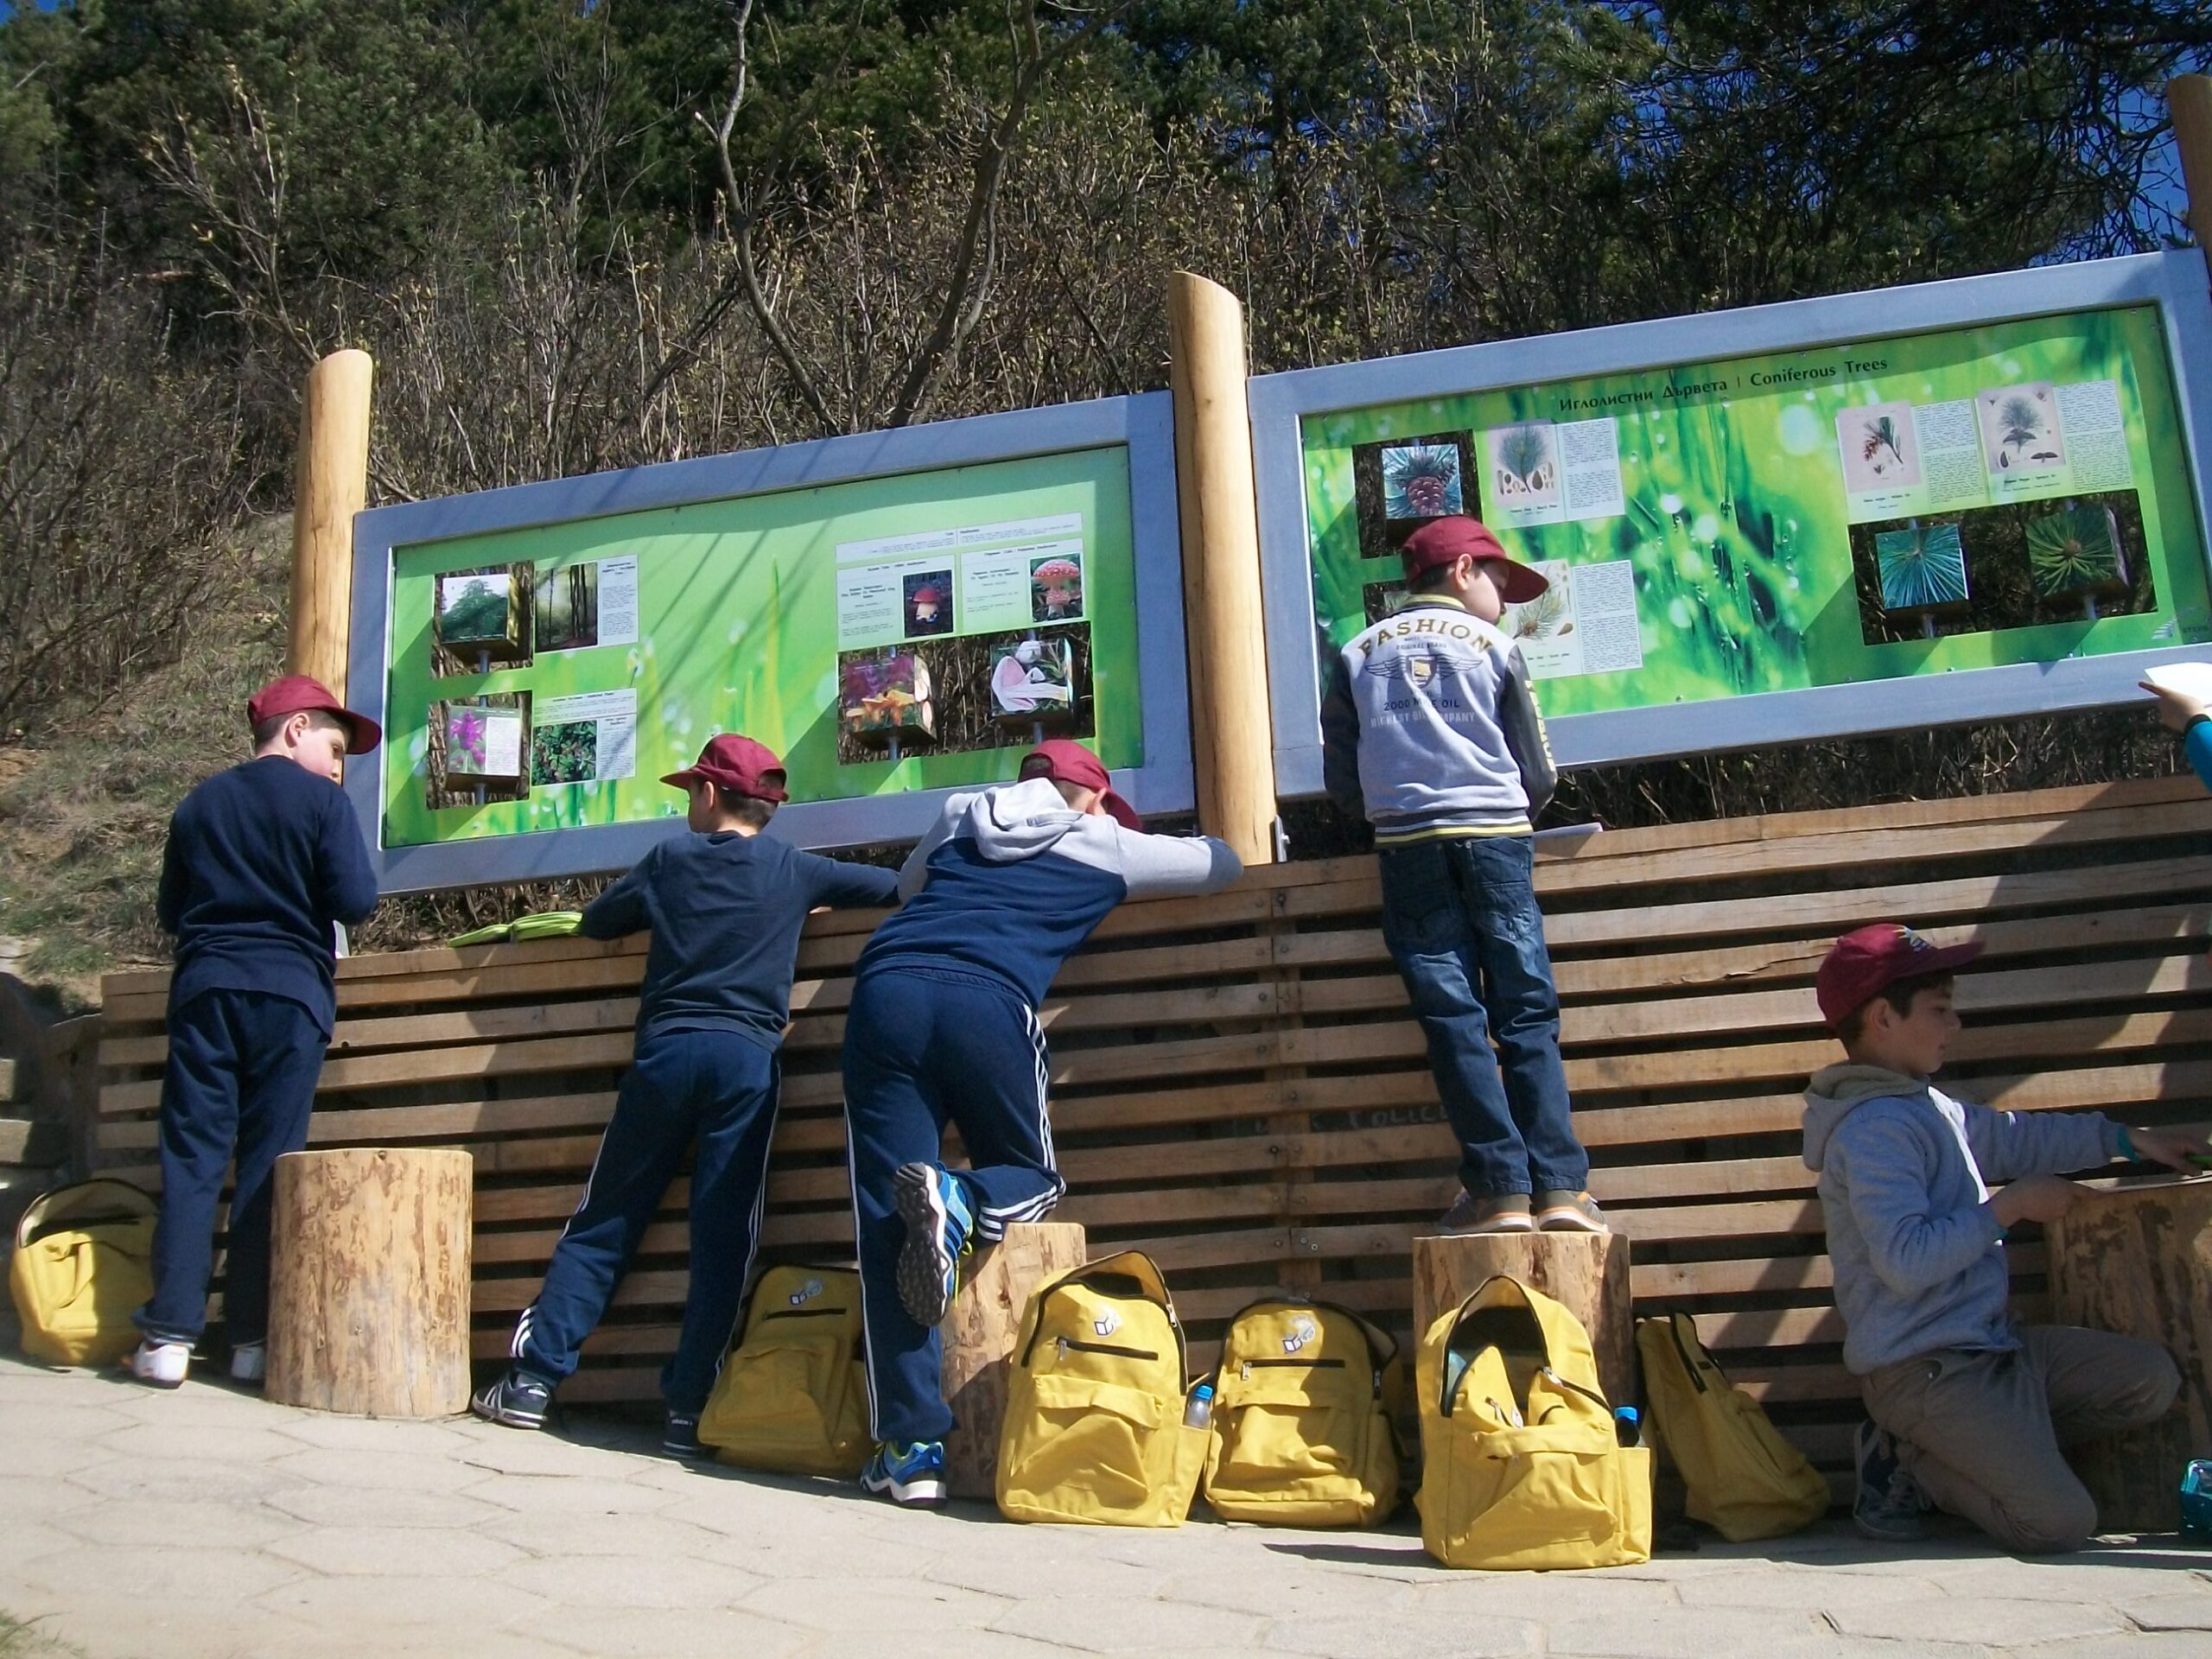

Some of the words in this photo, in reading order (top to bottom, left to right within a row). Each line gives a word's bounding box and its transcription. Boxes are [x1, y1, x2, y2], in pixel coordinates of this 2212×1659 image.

[1750, 366, 1836, 386] Coniferous
[1845, 359, 1888, 373] Trees
[1560, 390, 1654, 411] Иглолистни
[1662, 378, 1728, 400] Дървета
[1357, 619, 1493, 658] FASHION
[1383, 700, 1411, 711] 2000
[1441, 698, 1460, 709] OIL
